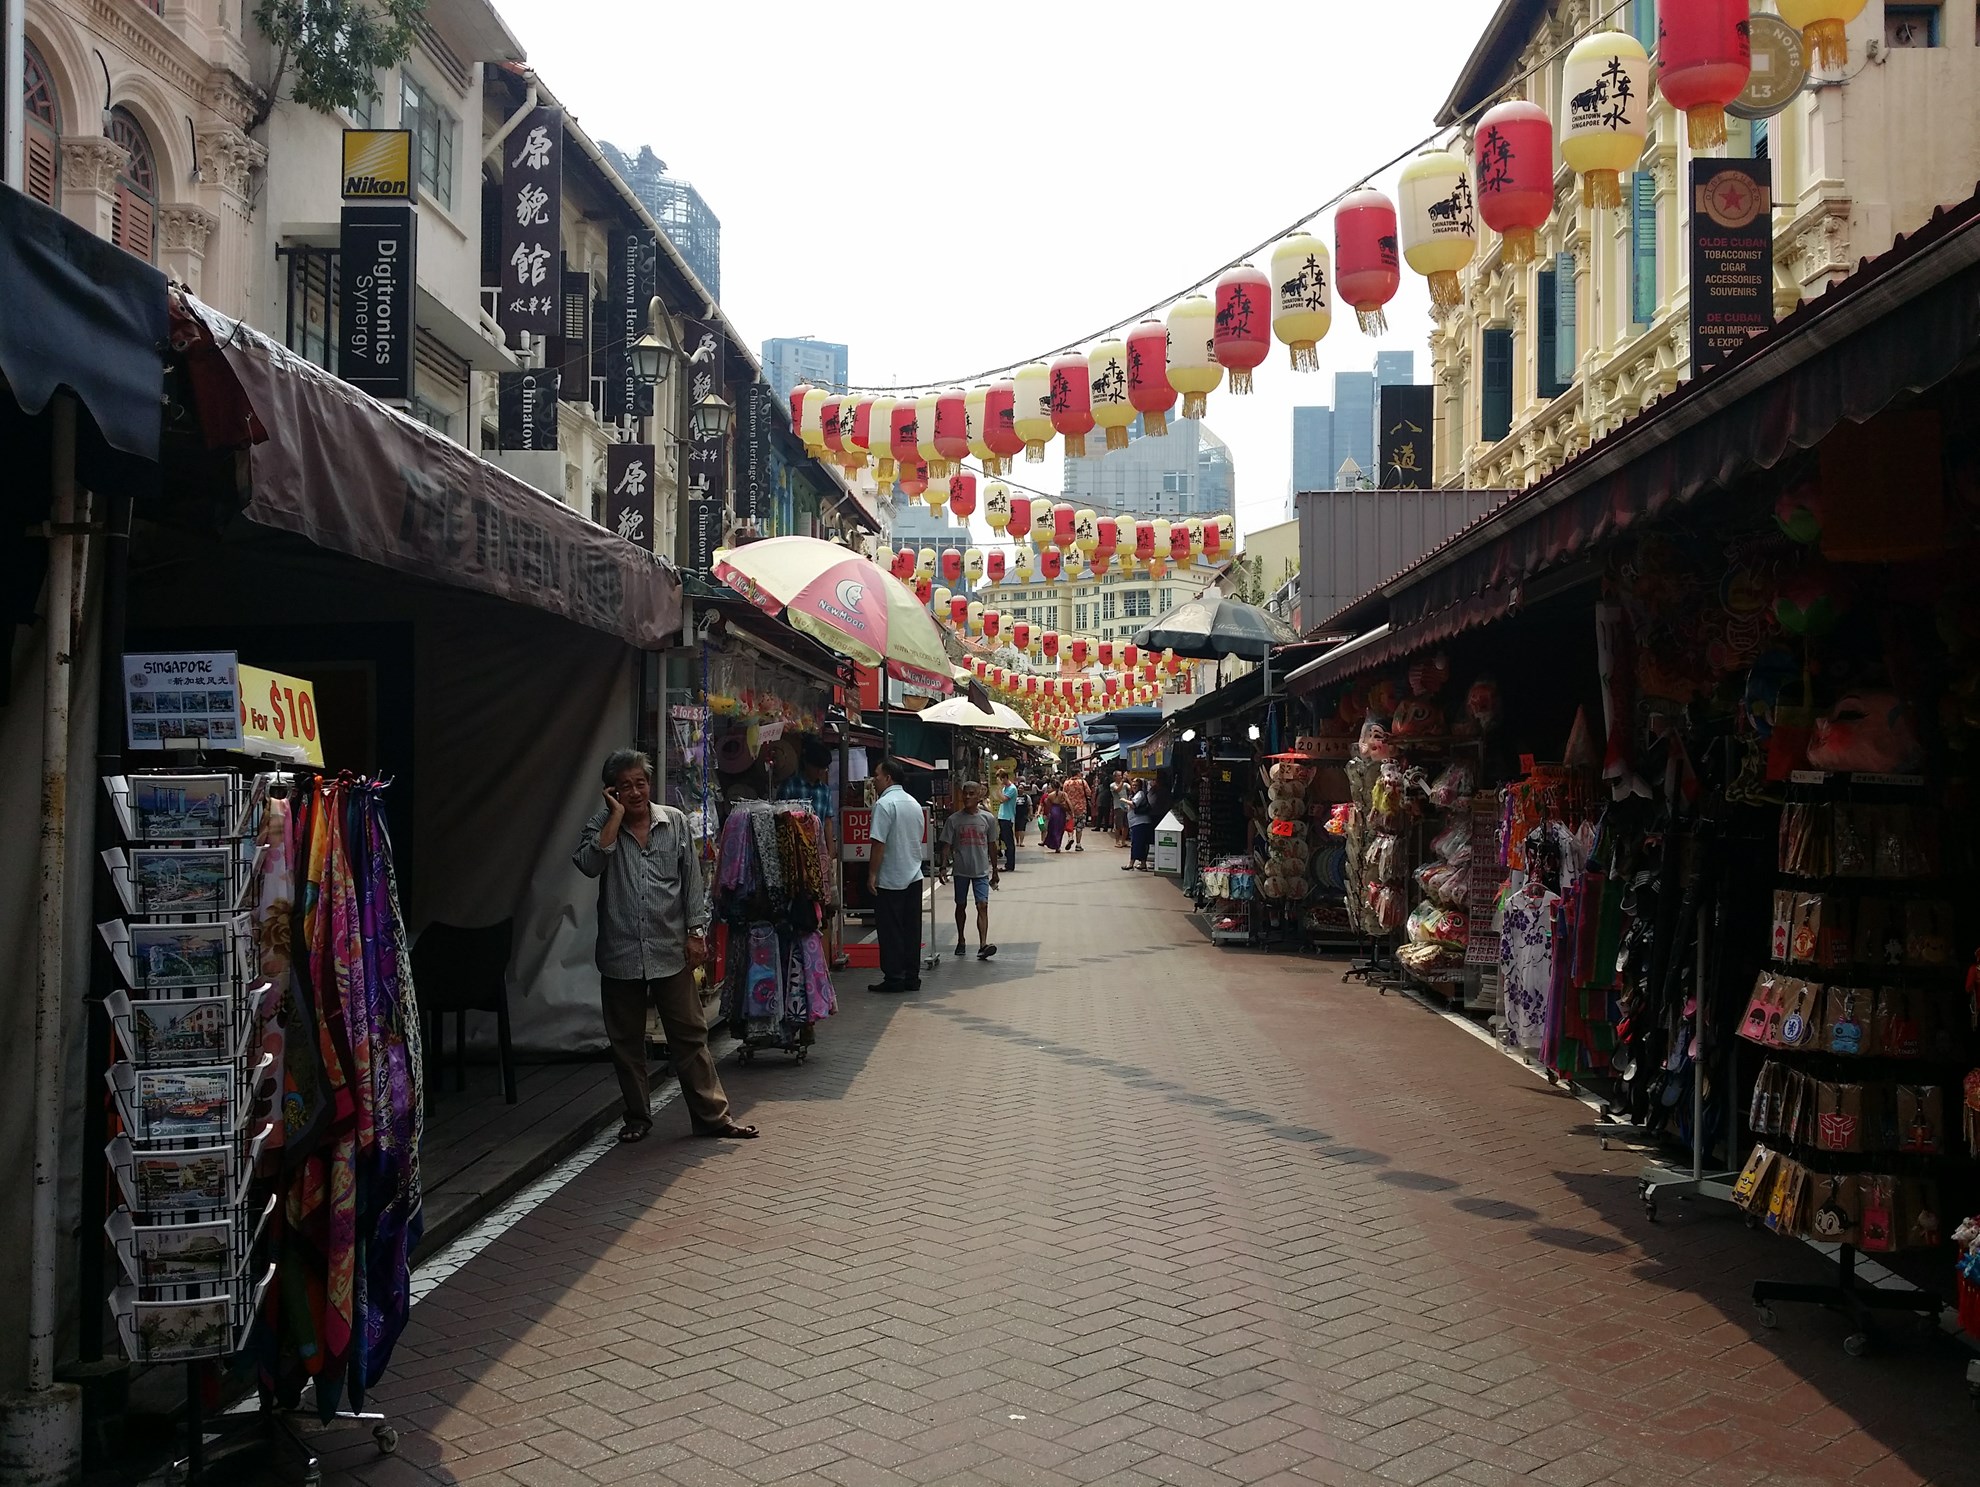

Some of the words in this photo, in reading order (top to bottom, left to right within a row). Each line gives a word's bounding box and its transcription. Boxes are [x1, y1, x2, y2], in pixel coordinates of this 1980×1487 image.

[1773, 28, 1799, 67] NOTES
[1601, 55, 1634, 131] 牛车水
[1751, 85, 1771, 97] L3
[1572, 113, 1601, 123] CHINATOWN
[1572, 120, 1600, 130] SINGAPORE
[1484, 125, 1515, 192] 牛车水
[345, 177, 405, 194] Nikon
[1432, 220, 1459, 228] CHINATOWN
[1699, 237, 1729, 247] OLDE
[1731, 237, 1767, 247] CUBAN
[1704, 250, 1762, 260] TOBACCONIST
[626, 235, 638, 304] Chinatown
[1721, 263, 1746, 272] CIGAR
[1302, 253, 1326, 312] 牛车水
[1705, 275, 1762, 284] ACCESSORIES
[1710, 287, 1757, 296] SOUVENIRS
[375, 239, 397, 364] Digitronics
[1282, 297, 1304, 305] CHINATOWN
[352, 275, 373, 358] Synergy
[1230, 284, 1254, 338] 牛车水
[1706, 313, 1721, 322] DE
[1724, 313, 1761, 322] CUBAN
[1699, 325, 1725, 334] CIGAR
[1708, 338, 1715, 347] &
[1106, 357, 1127, 405] 牛车水
[750, 387, 759, 437] Chinatown
[748, 442, 759, 480] Heritage
[750, 482, 759, 516] Centre
[698, 505, 709, 563] Chinatown
[830, 633, 872, 663] Singapore
[143, 660, 212, 674] SINGAPORE
[172, 677, 229, 686] 新加坡风光
[251, 707, 268, 731] For
[270, 680, 316, 742] $10
[680, 708, 691, 718] for
[849, 814, 872, 827] DU
